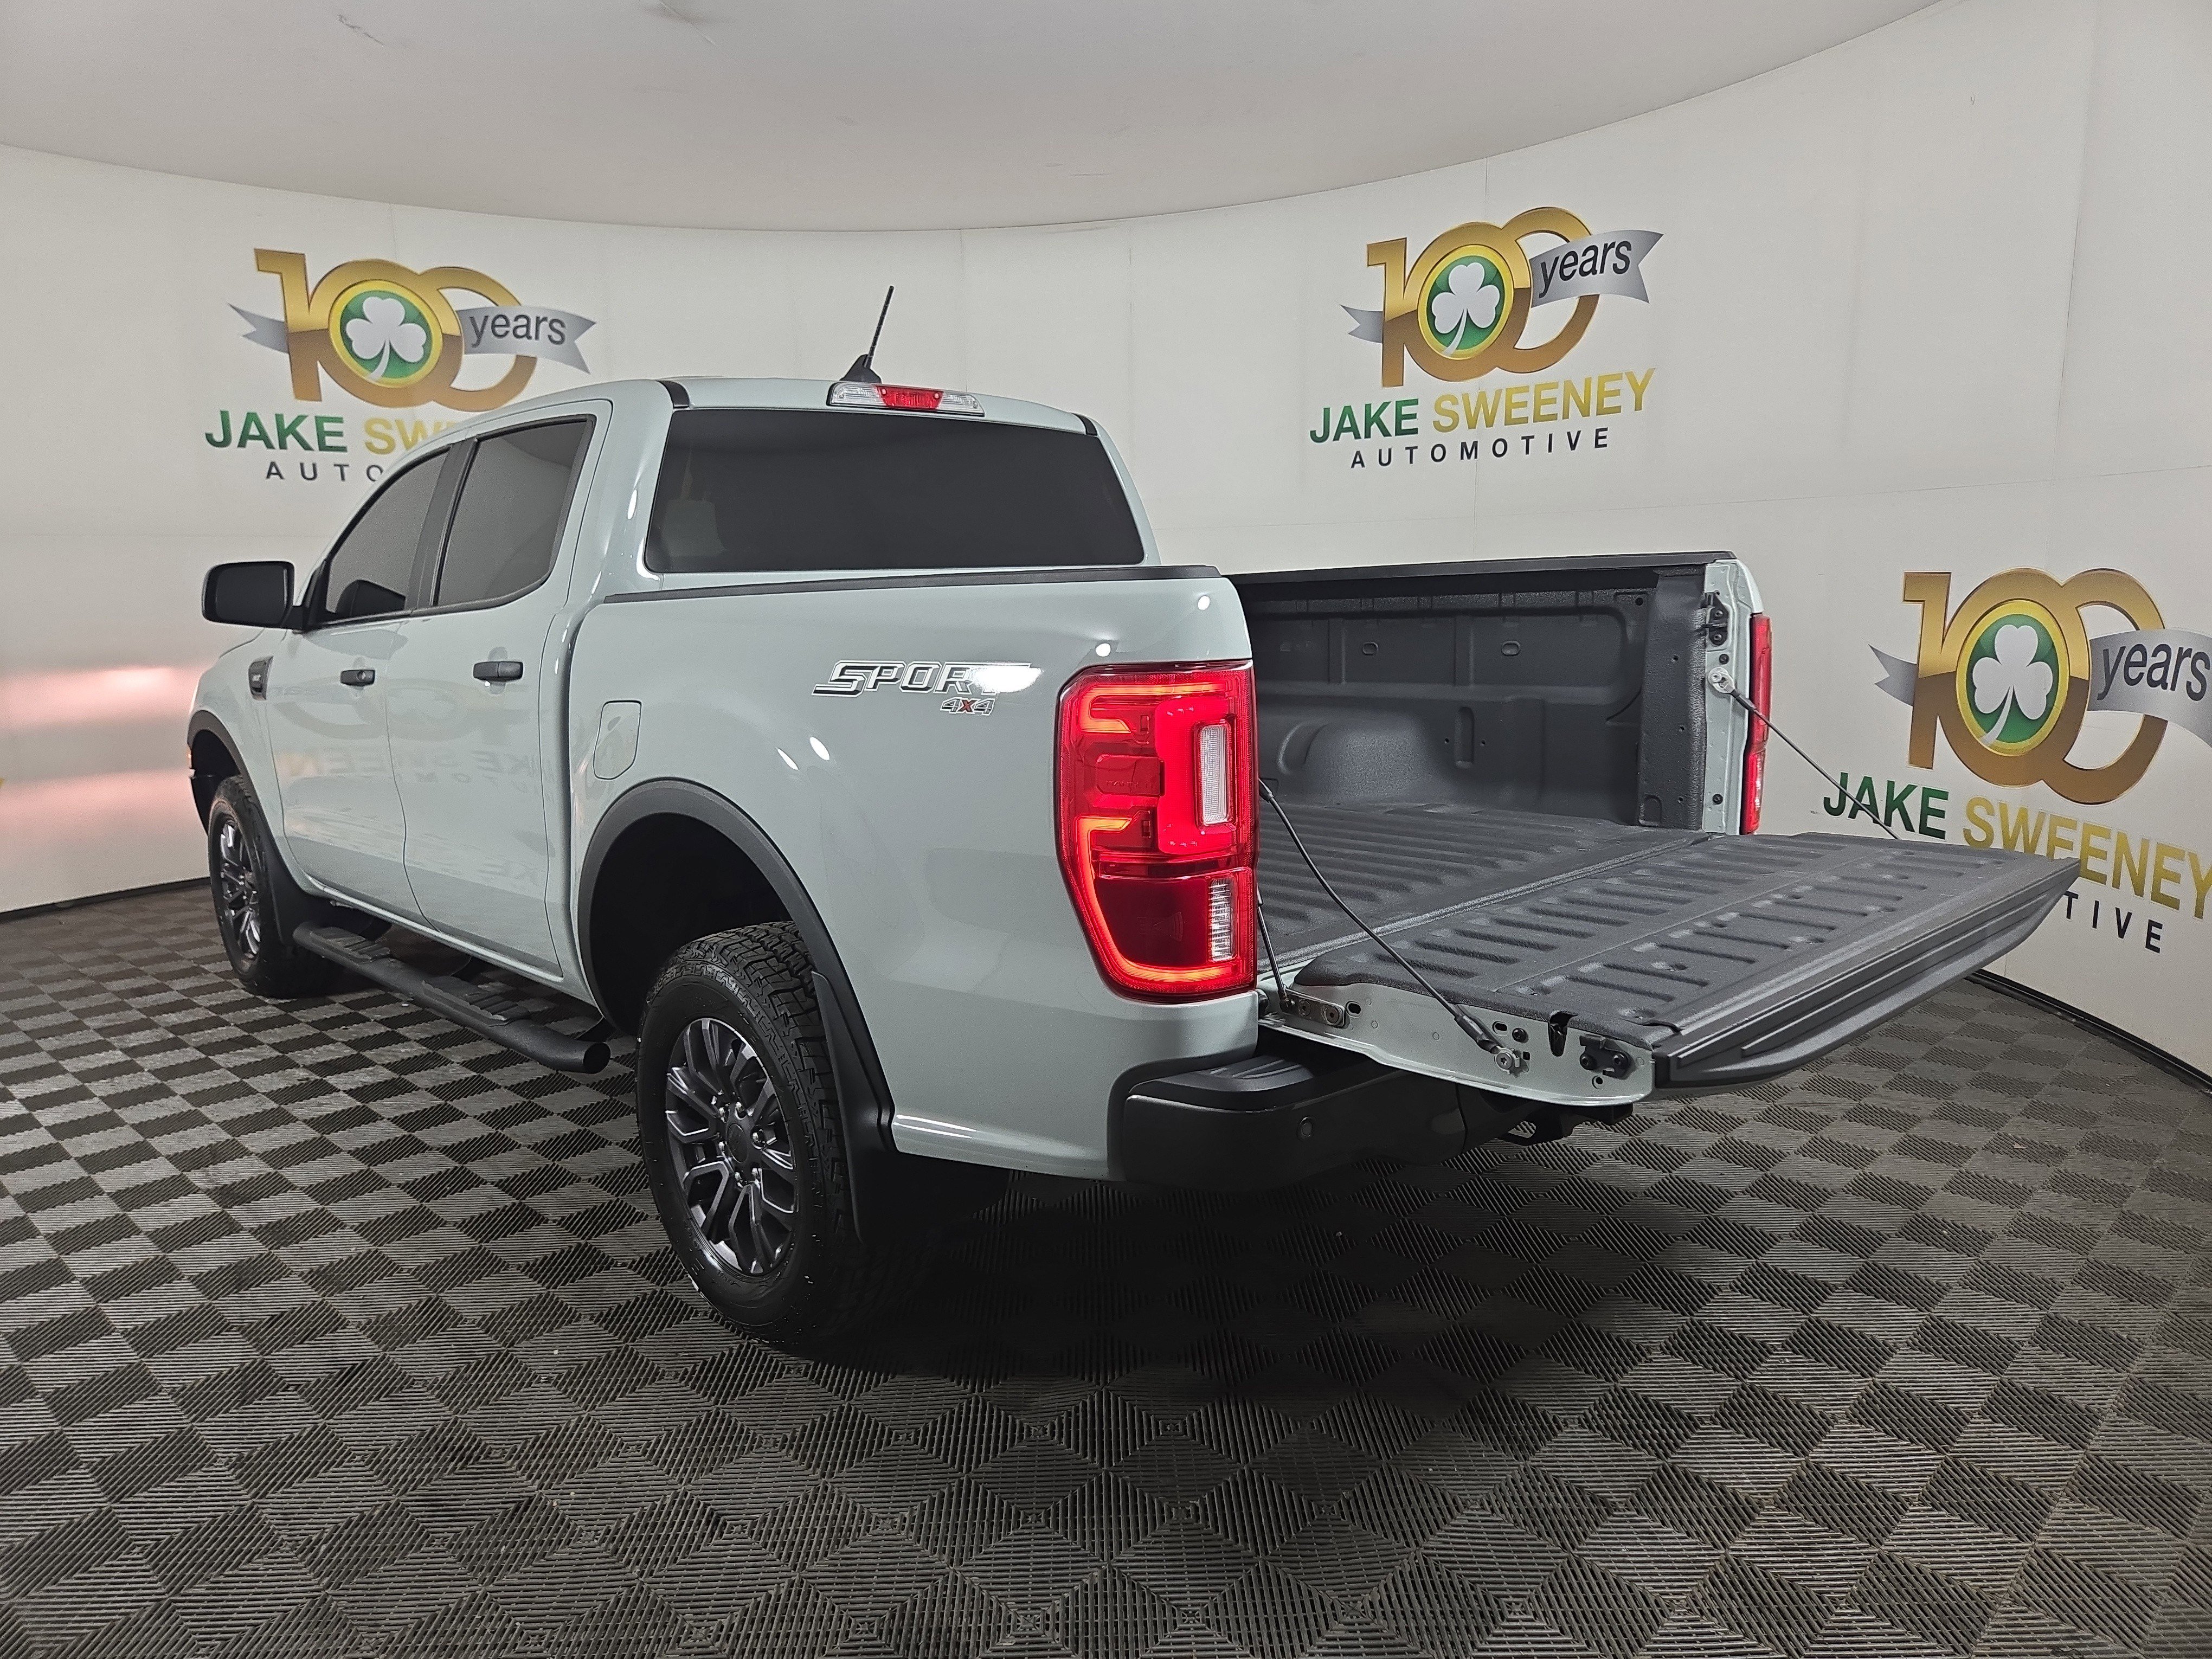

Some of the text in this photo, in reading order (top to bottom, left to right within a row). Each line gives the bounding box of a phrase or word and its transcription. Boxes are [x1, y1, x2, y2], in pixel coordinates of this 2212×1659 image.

[1366, 207, 1600, 388] 100
[1539, 239, 1632, 299] years
[254, 248, 538, 413] 100
[470, 313, 567, 349] years
[204, 410, 348, 454] JAKE
[1309, 368, 1656, 443] JAKE SWEENEY
[1351, 427, 1609, 468] AUTOMOTIVE
[1902, 567, 2169, 805] 100
[2097, 643, 2211, 702] years
[1823, 771, 2212, 920] JAKE SWEENEY
